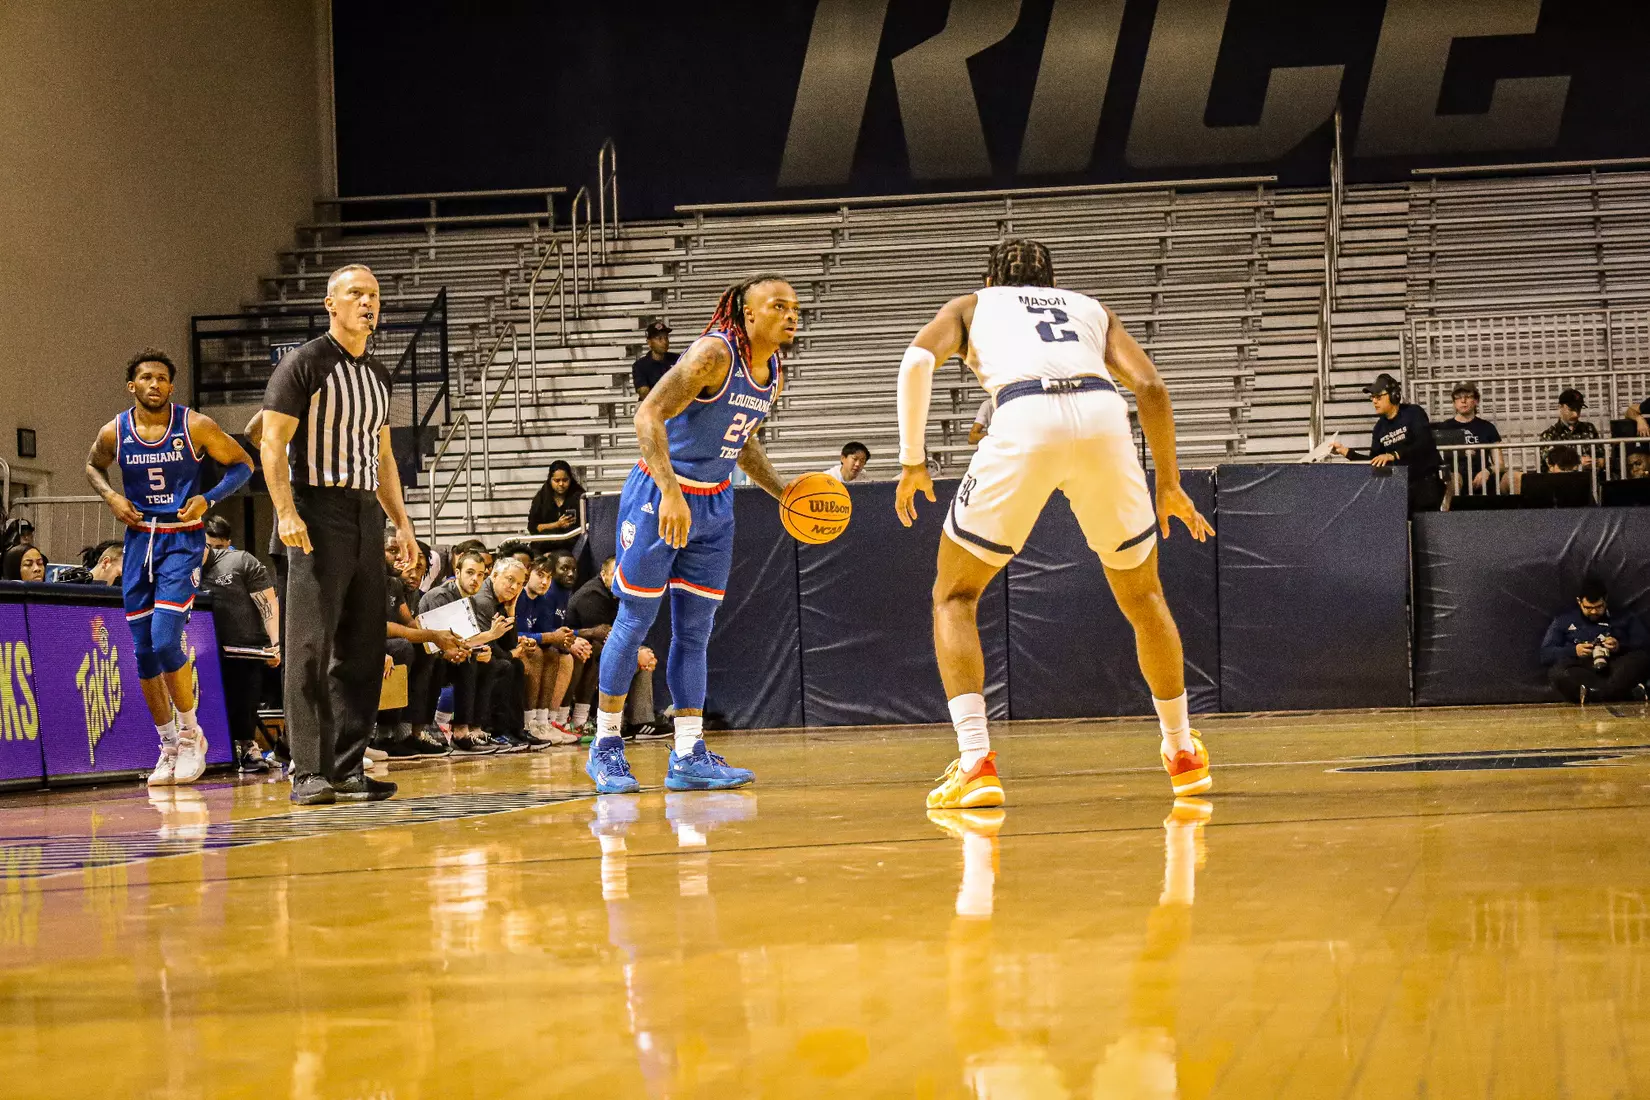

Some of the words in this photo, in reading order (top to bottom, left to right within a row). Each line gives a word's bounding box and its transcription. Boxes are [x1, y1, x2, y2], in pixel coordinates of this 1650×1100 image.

[1018, 295, 1067, 307] MASON
[1026, 305, 1080, 342] 2
[723, 412, 758, 443] 24
[125, 450, 184, 465] LOUISIANA
[147, 467, 166, 491] 5
[145, 493, 174, 504] TECH
[808, 499, 850, 515] Wilson
[0, 640, 39, 741] KS
[75, 628, 122, 767] Takis
